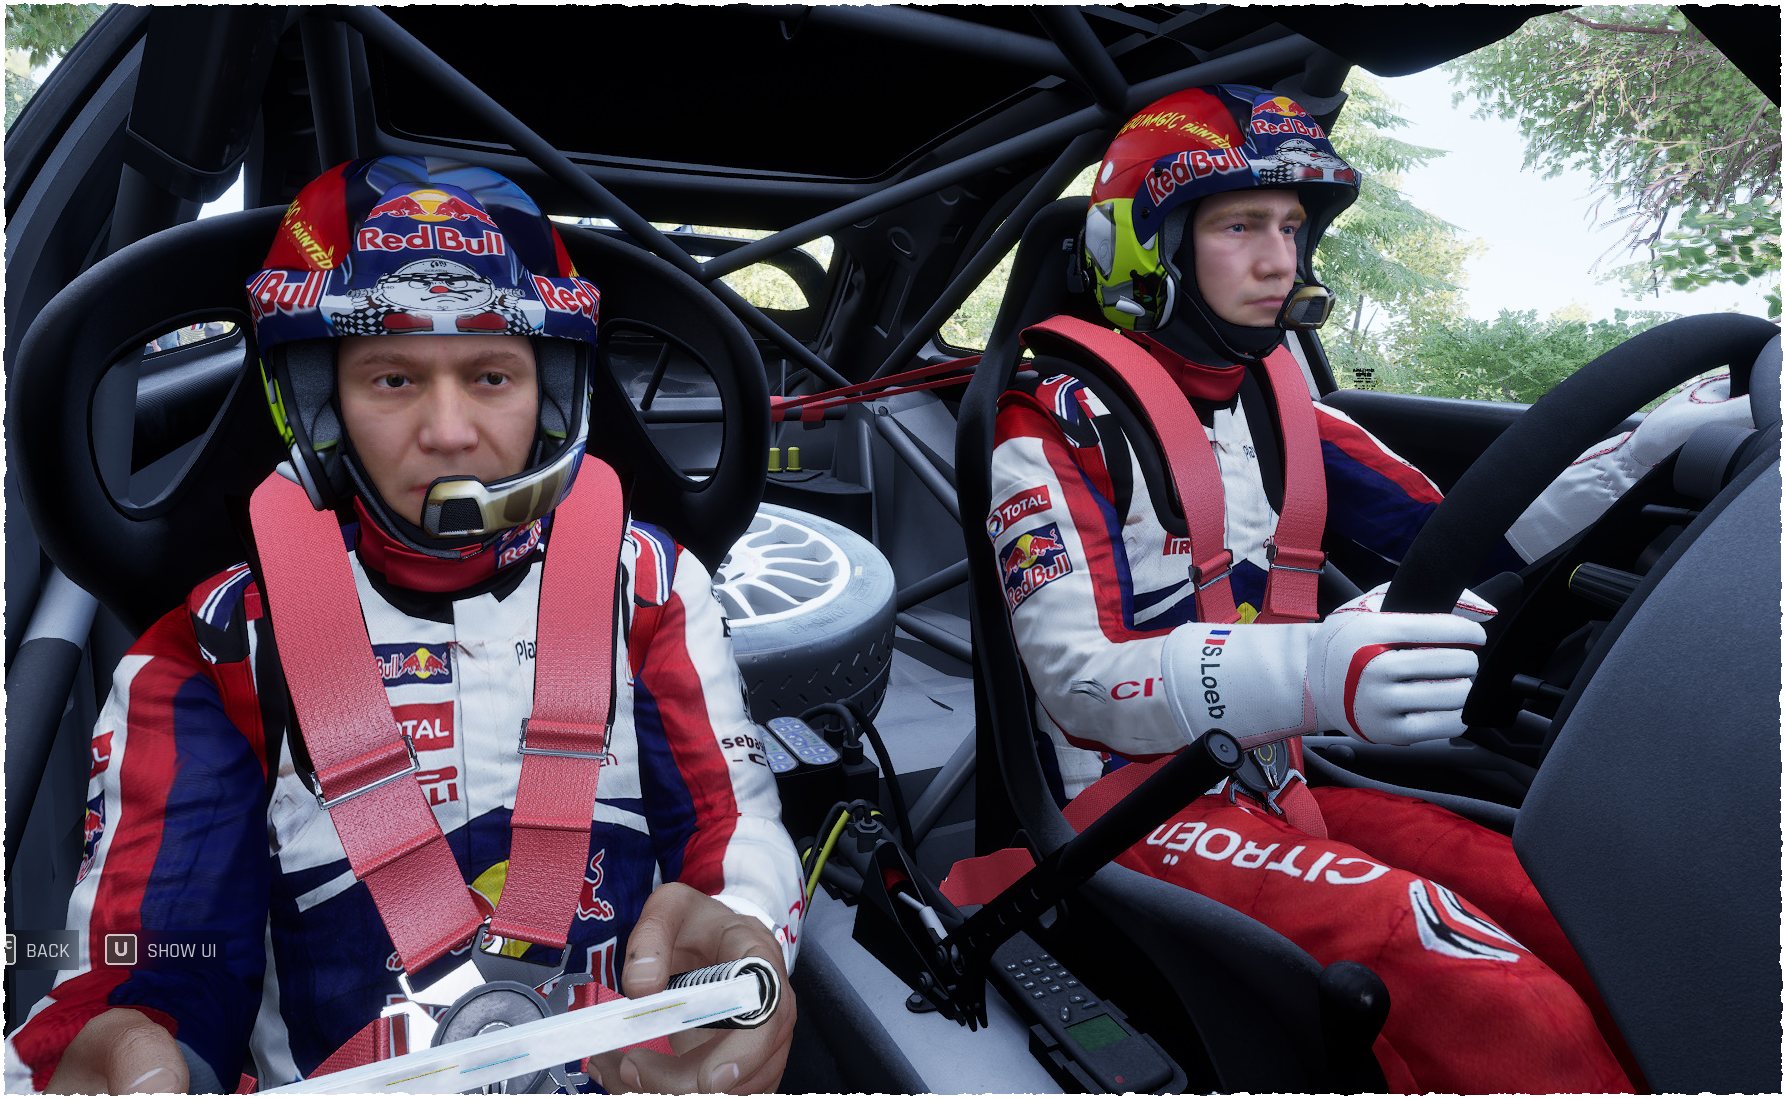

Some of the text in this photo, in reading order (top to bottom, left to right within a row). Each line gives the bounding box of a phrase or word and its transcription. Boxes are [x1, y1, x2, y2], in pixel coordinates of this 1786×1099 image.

[1251, 117, 1296, 135] Red
[1145, 146, 1248, 207] Red Bull
[357, 224, 505, 257] Red Bull
[254, 270, 327, 317] Bull
[532, 275, 597, 319] Red
[1003, 494, 1048, 521] TOTAL
[1007, 552, 1070, 612] Red Bull
[1201, 645, 1226, 720] S.Loeb
[398, 718, 450, 740] TAL
